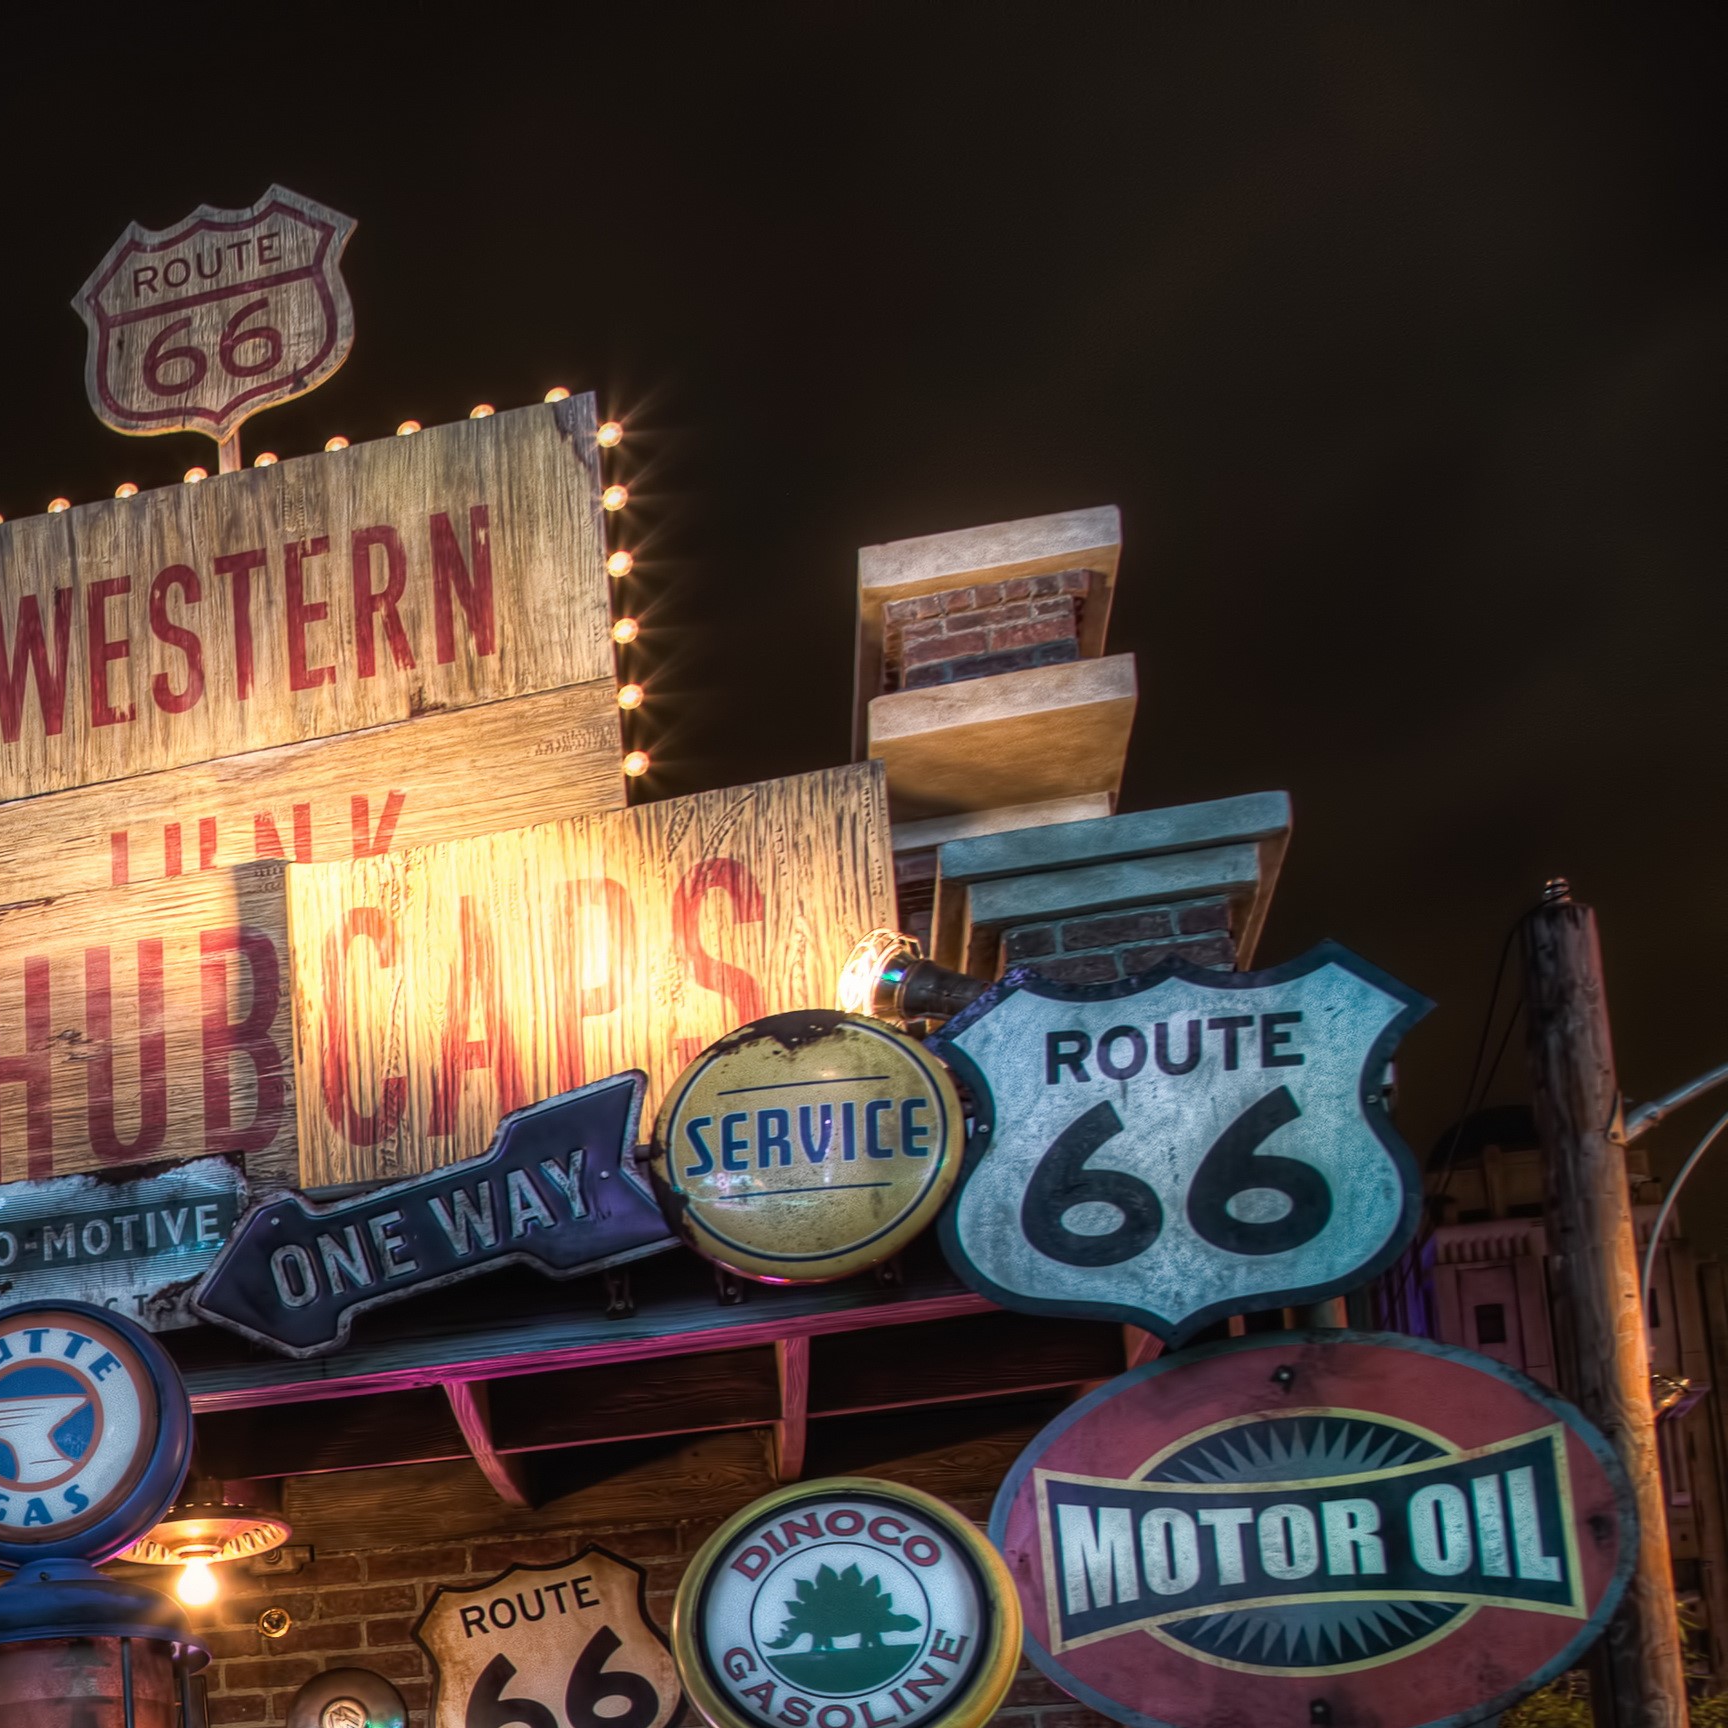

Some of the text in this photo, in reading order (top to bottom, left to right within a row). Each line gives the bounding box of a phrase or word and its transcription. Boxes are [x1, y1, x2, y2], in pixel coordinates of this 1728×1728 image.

[131, 232, 285, 298] ROUTE
[142, 296, 285, 399] 66
[321, 856, 768, 1150] CAPS
[1044, 1010, 1307, 1087] ROUTE
[683, 1096, 931, 1177] SERVICE
[1020, 1085, 1334, 1268] 66
[270, 1149, 588, 1309] ONE WAY
[731, 1508, 944, 1583] DINOCO
[1052, 1464, 1564, 1616] MOTOR OIL
[458, 1575, 601, 1639] ROUTE
